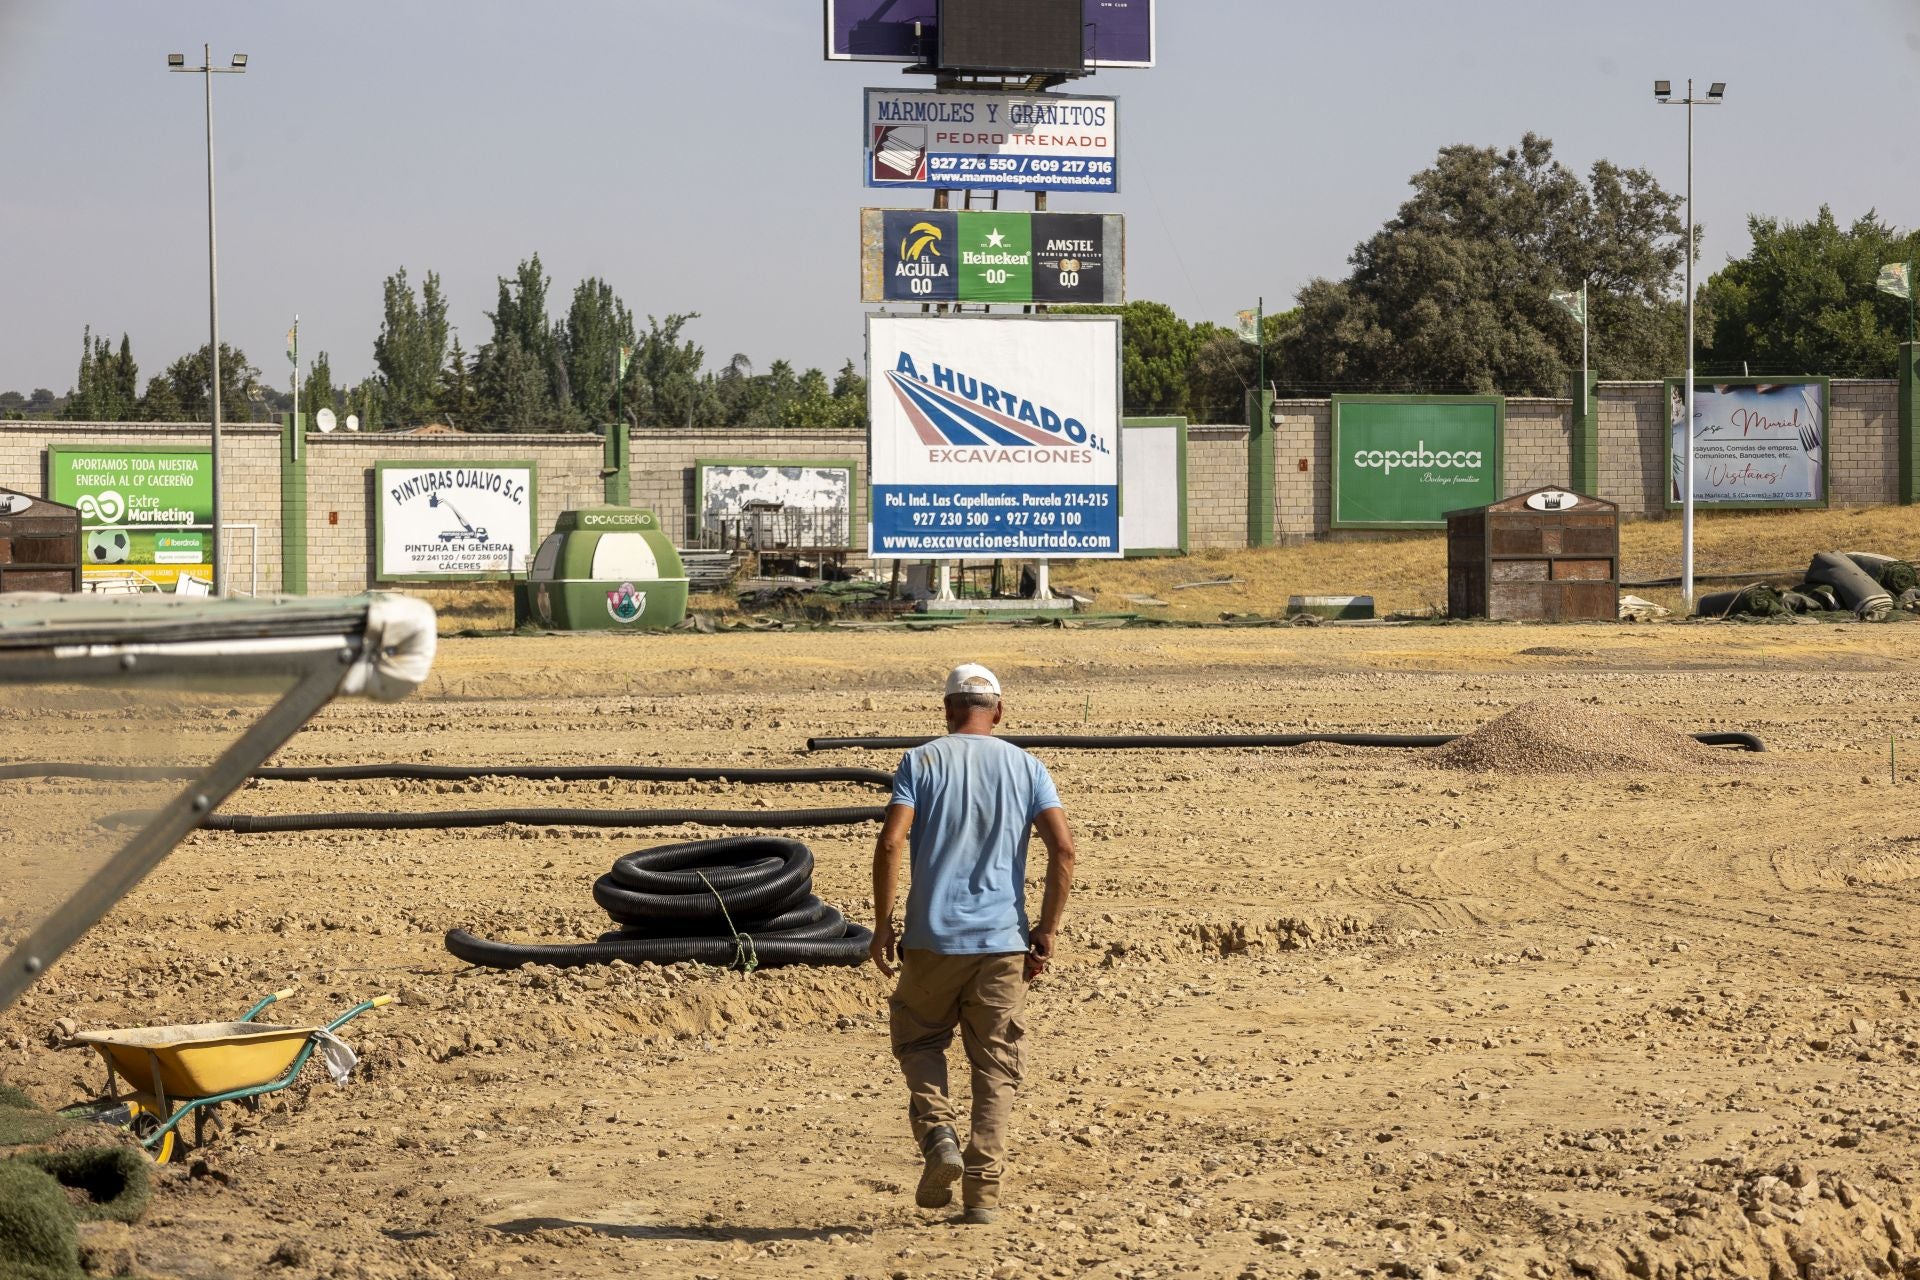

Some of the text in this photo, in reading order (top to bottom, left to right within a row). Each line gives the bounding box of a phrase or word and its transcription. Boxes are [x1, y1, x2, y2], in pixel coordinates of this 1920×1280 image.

[878, 97, 1106, 127] MÁRMOLES Y GRANITOS
[936, 132, 1107, 147] PEDRO TRENADO
[930, 157, 1113, 173] 927 276 550 / 609 217 916
[930, 170, 1113, 186] www.marmolespedrotrenado.es
[1046, 239, 1094, 252] AMSTEL
[920, 255, 931, 263] EL
[962, 251, 1030, 265] Heineken
[895, 259, 949, 277] ÁGUILA
[910, 278, 932, 295] 0,0
[1059, 271, 1079, 289] 0,0
[1731, 408, 1801, 437] Muriel
[1089, 433, 1111, 455] S.L.
[928, 449, 1093, 464] EXCAVACIONES
[1354, 440, 1482, 475] copaboca
[1694, 452, 1738, 460] Comuniones,
[1739, 452, 1777, 460] Banquetes,
[71, 458, 199, 471] APORTAMOS TODA NUESTRA
[76, 472, 194, 487] ENERGÍA AL CP CACEREÑO
[391, 469, 524, 506] PINTURAS OJALVO S.C.
[128, 494, 160, 508] Extre
[885, 492, 1109, 509] Pol. Ind. Las Capellanías. Parcela 214-215
[127, 507, 195, 526] Marketing
[912, 512, 1082, 527] 927 230 500 927 269 100
[882, 530, 1112, 549] www.excavacioneshurtado.com
[405, 543, 514, 553] PINTURA EN GENERAL
[438, 561, 481, 570] CÁCERES
